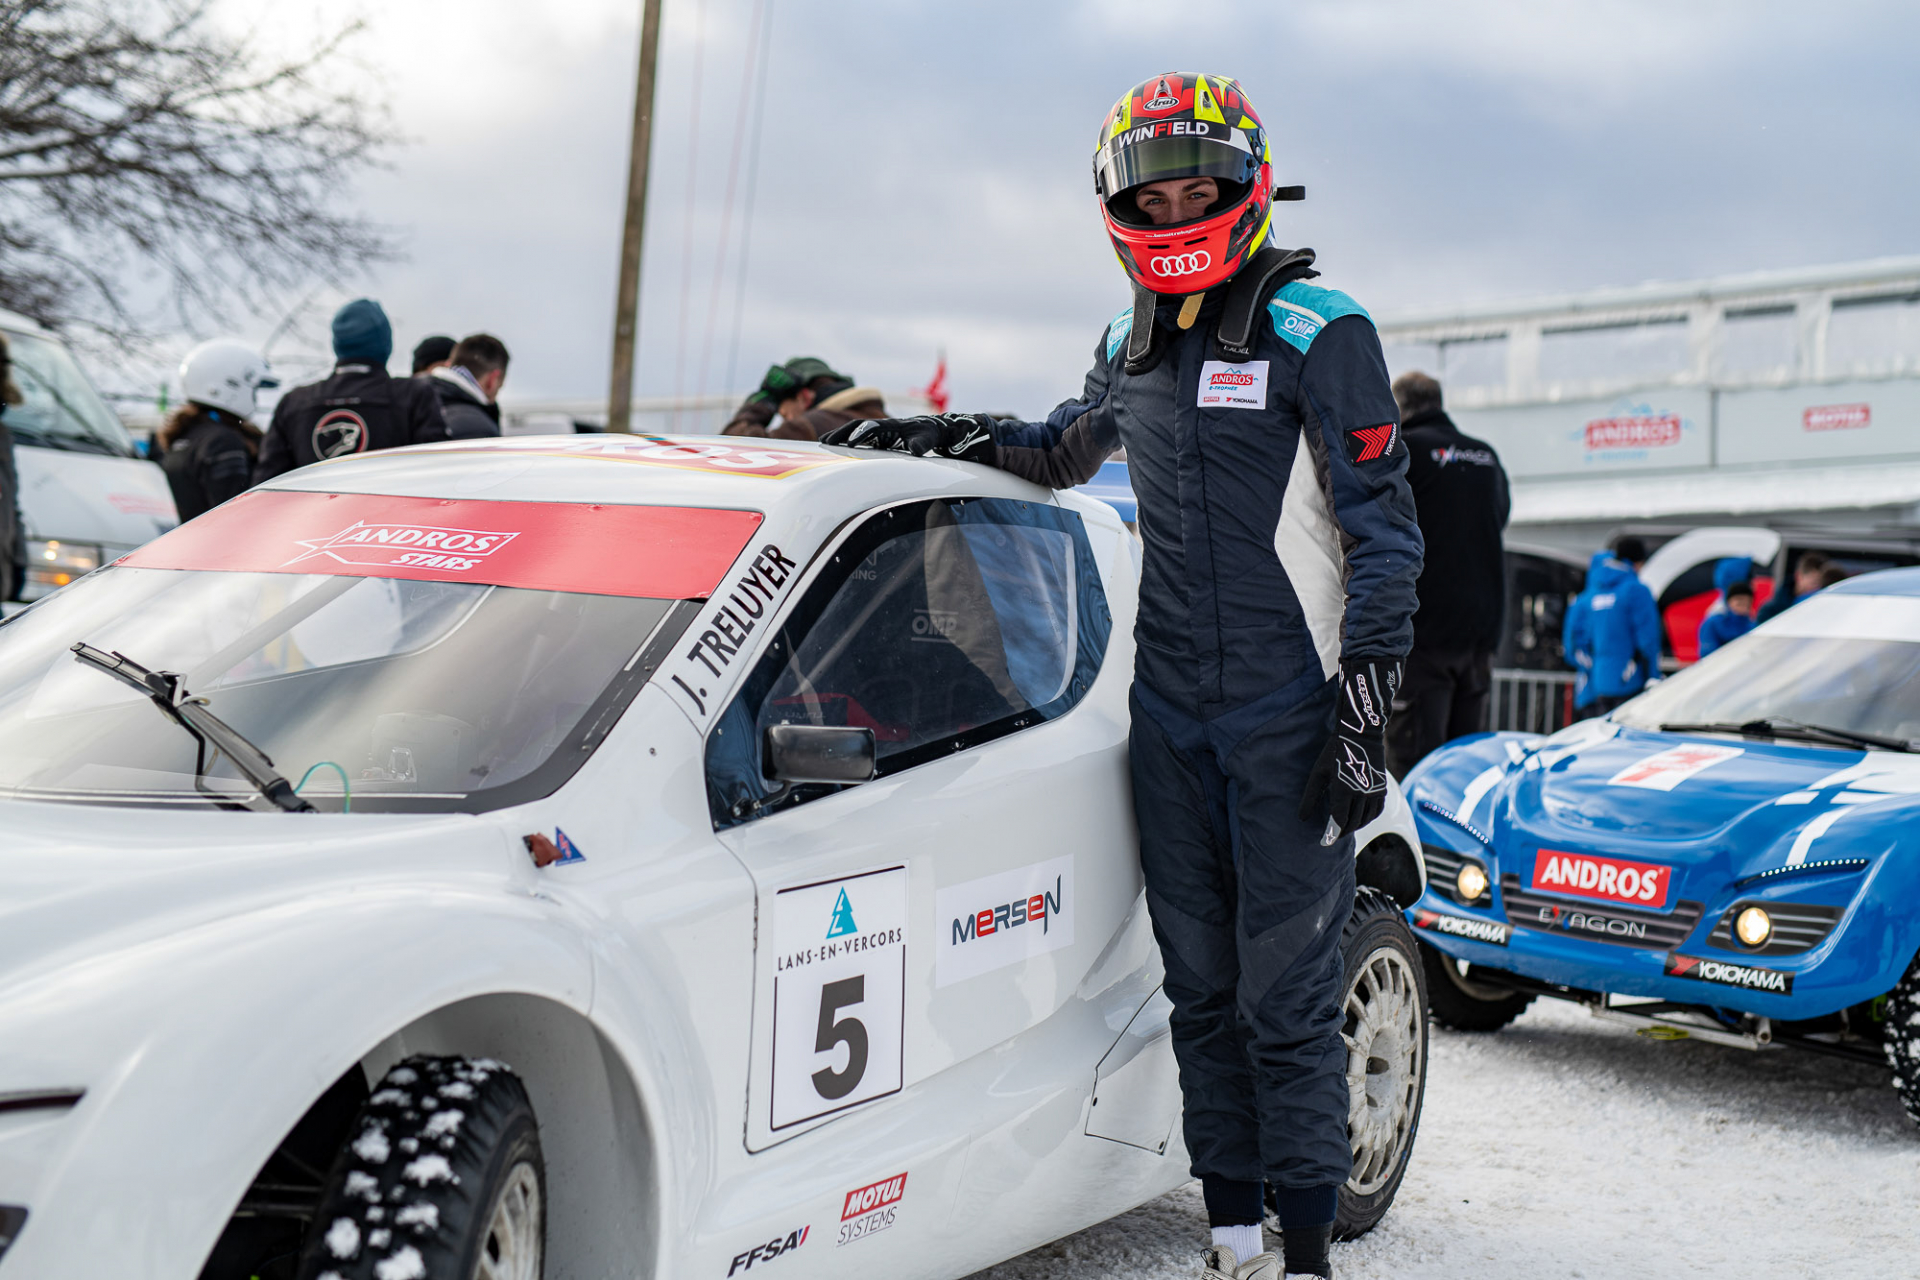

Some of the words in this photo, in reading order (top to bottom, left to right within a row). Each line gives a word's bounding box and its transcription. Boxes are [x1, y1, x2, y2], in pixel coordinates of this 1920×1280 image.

[1150, 98, 1174, 108] Arai
[1118, 121, 1210, 149] WINFIELD
[1284, 316, 1317, 336] OMP
[1211, 374, 1252, 385] ANDROS
[338, 528, 501, 552] ANDROS
[389, 552, 484, 571] STARS
[686, 543, 797, 679] TRELUYER
[911, 615, 958, 637] OMP
[671, 674, 707, 716] J.
[1540, 855, 1659, 901] ANDROS
[1437, 913, 1506, 944] YOKOHAMA
[777, 927, 902, 972] LANS-EN-VERCORS
[1699, 960, 1786, 992] YOKOHAMA
[811, 974, 869, 1100] 5
[844, 1176, 903, 1217] MOTUL
[837, 1206, 898, 1246] SYSTEMS
[727, 1230, 799, 1278] FFSA
